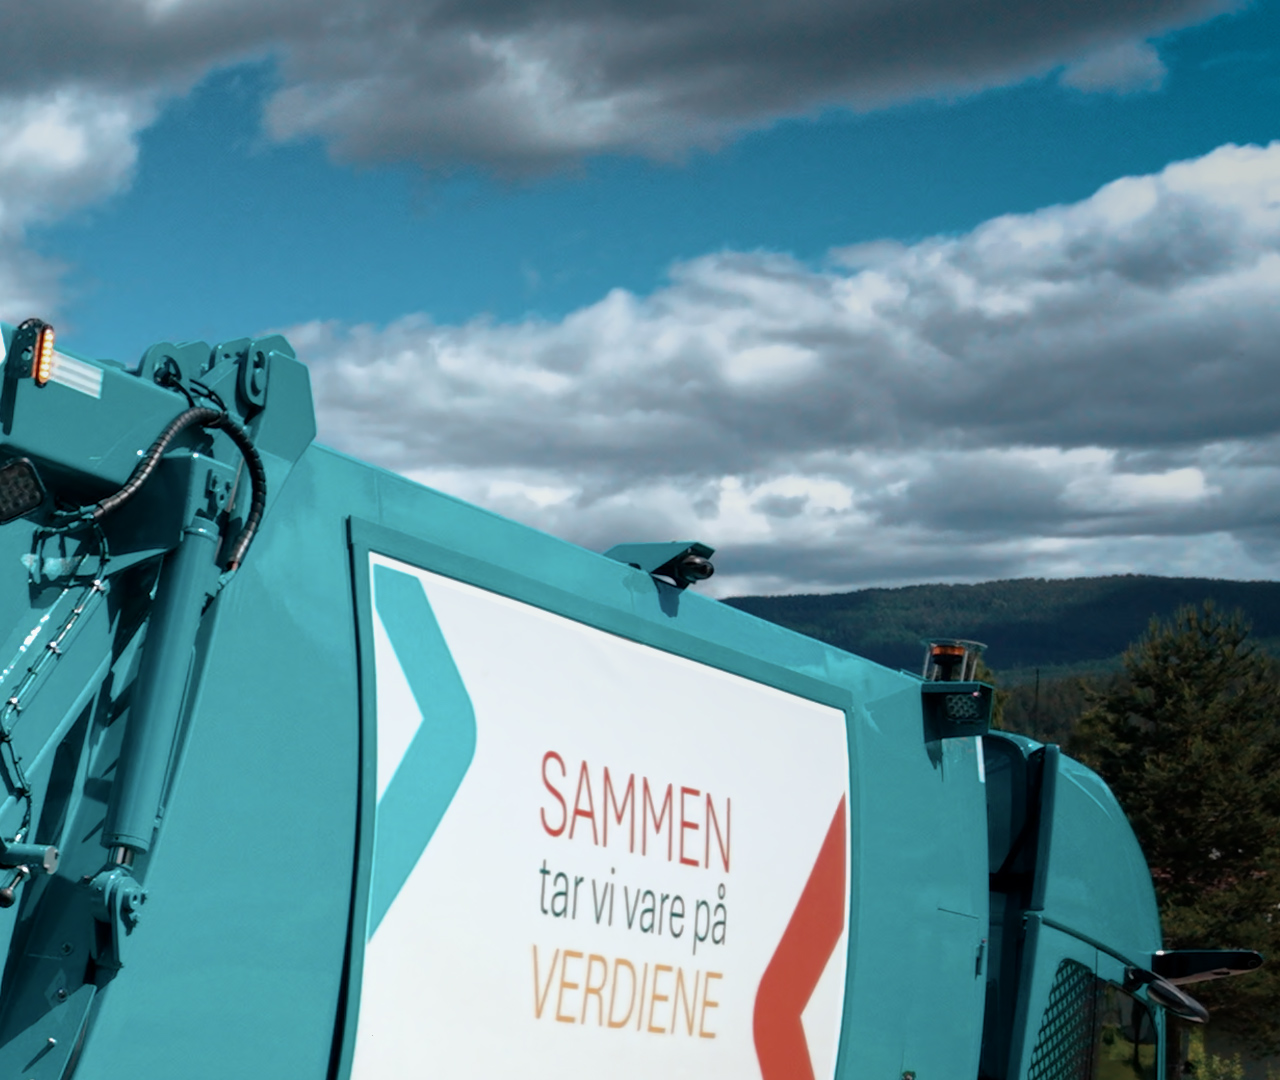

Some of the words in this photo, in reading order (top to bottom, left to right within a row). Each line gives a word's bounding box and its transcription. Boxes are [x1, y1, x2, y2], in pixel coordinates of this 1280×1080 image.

[540, 750, 731, 874] SAMMEN
[540, 859, 584, 921] tar
[592, 867, 615, 927] vi
[624, 885, 686, 939] vare
[692, 882, 728, 956] på
[533, 943, 724, 1040] VERDIENE
